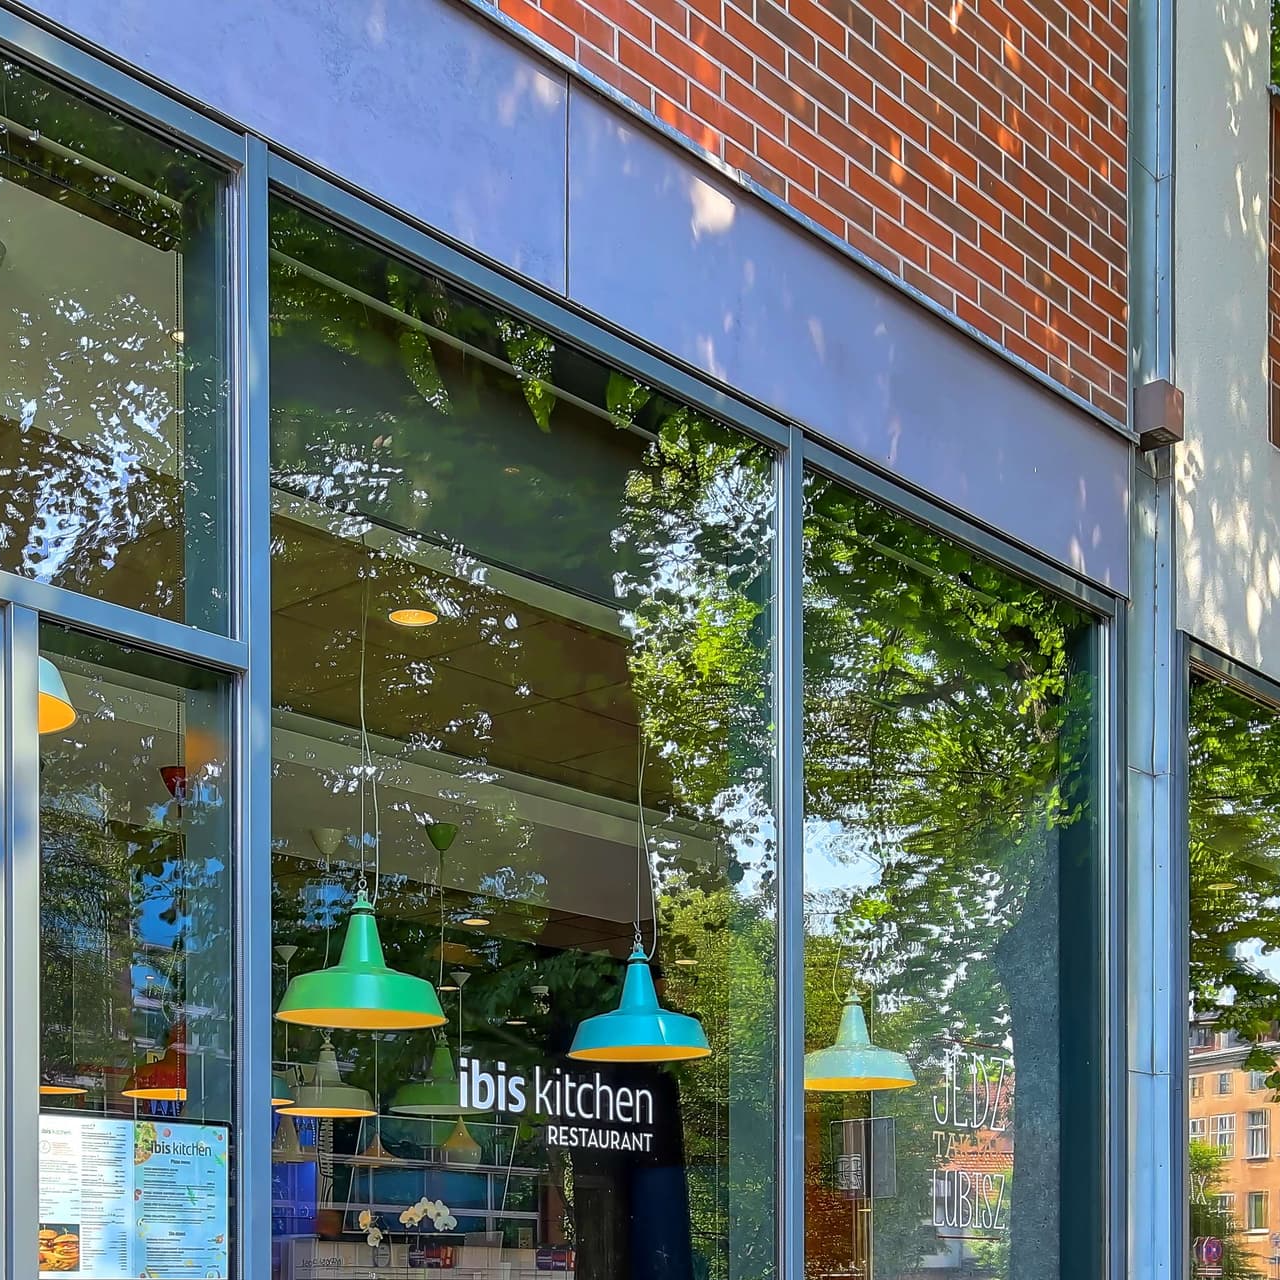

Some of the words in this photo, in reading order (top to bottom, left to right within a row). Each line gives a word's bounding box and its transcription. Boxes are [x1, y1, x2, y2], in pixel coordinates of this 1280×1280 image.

[459, 1057, 527, 1113] ibis
[534, 1065, 654, 1125] kitchen
[933, 1048, 1006, 1131] JEDZ
[151, 1140, 171, 1154] ibis
[172, 1142, 212, 1157] kitchen
[547, 1126, 654, 1152] RESTAURANT
